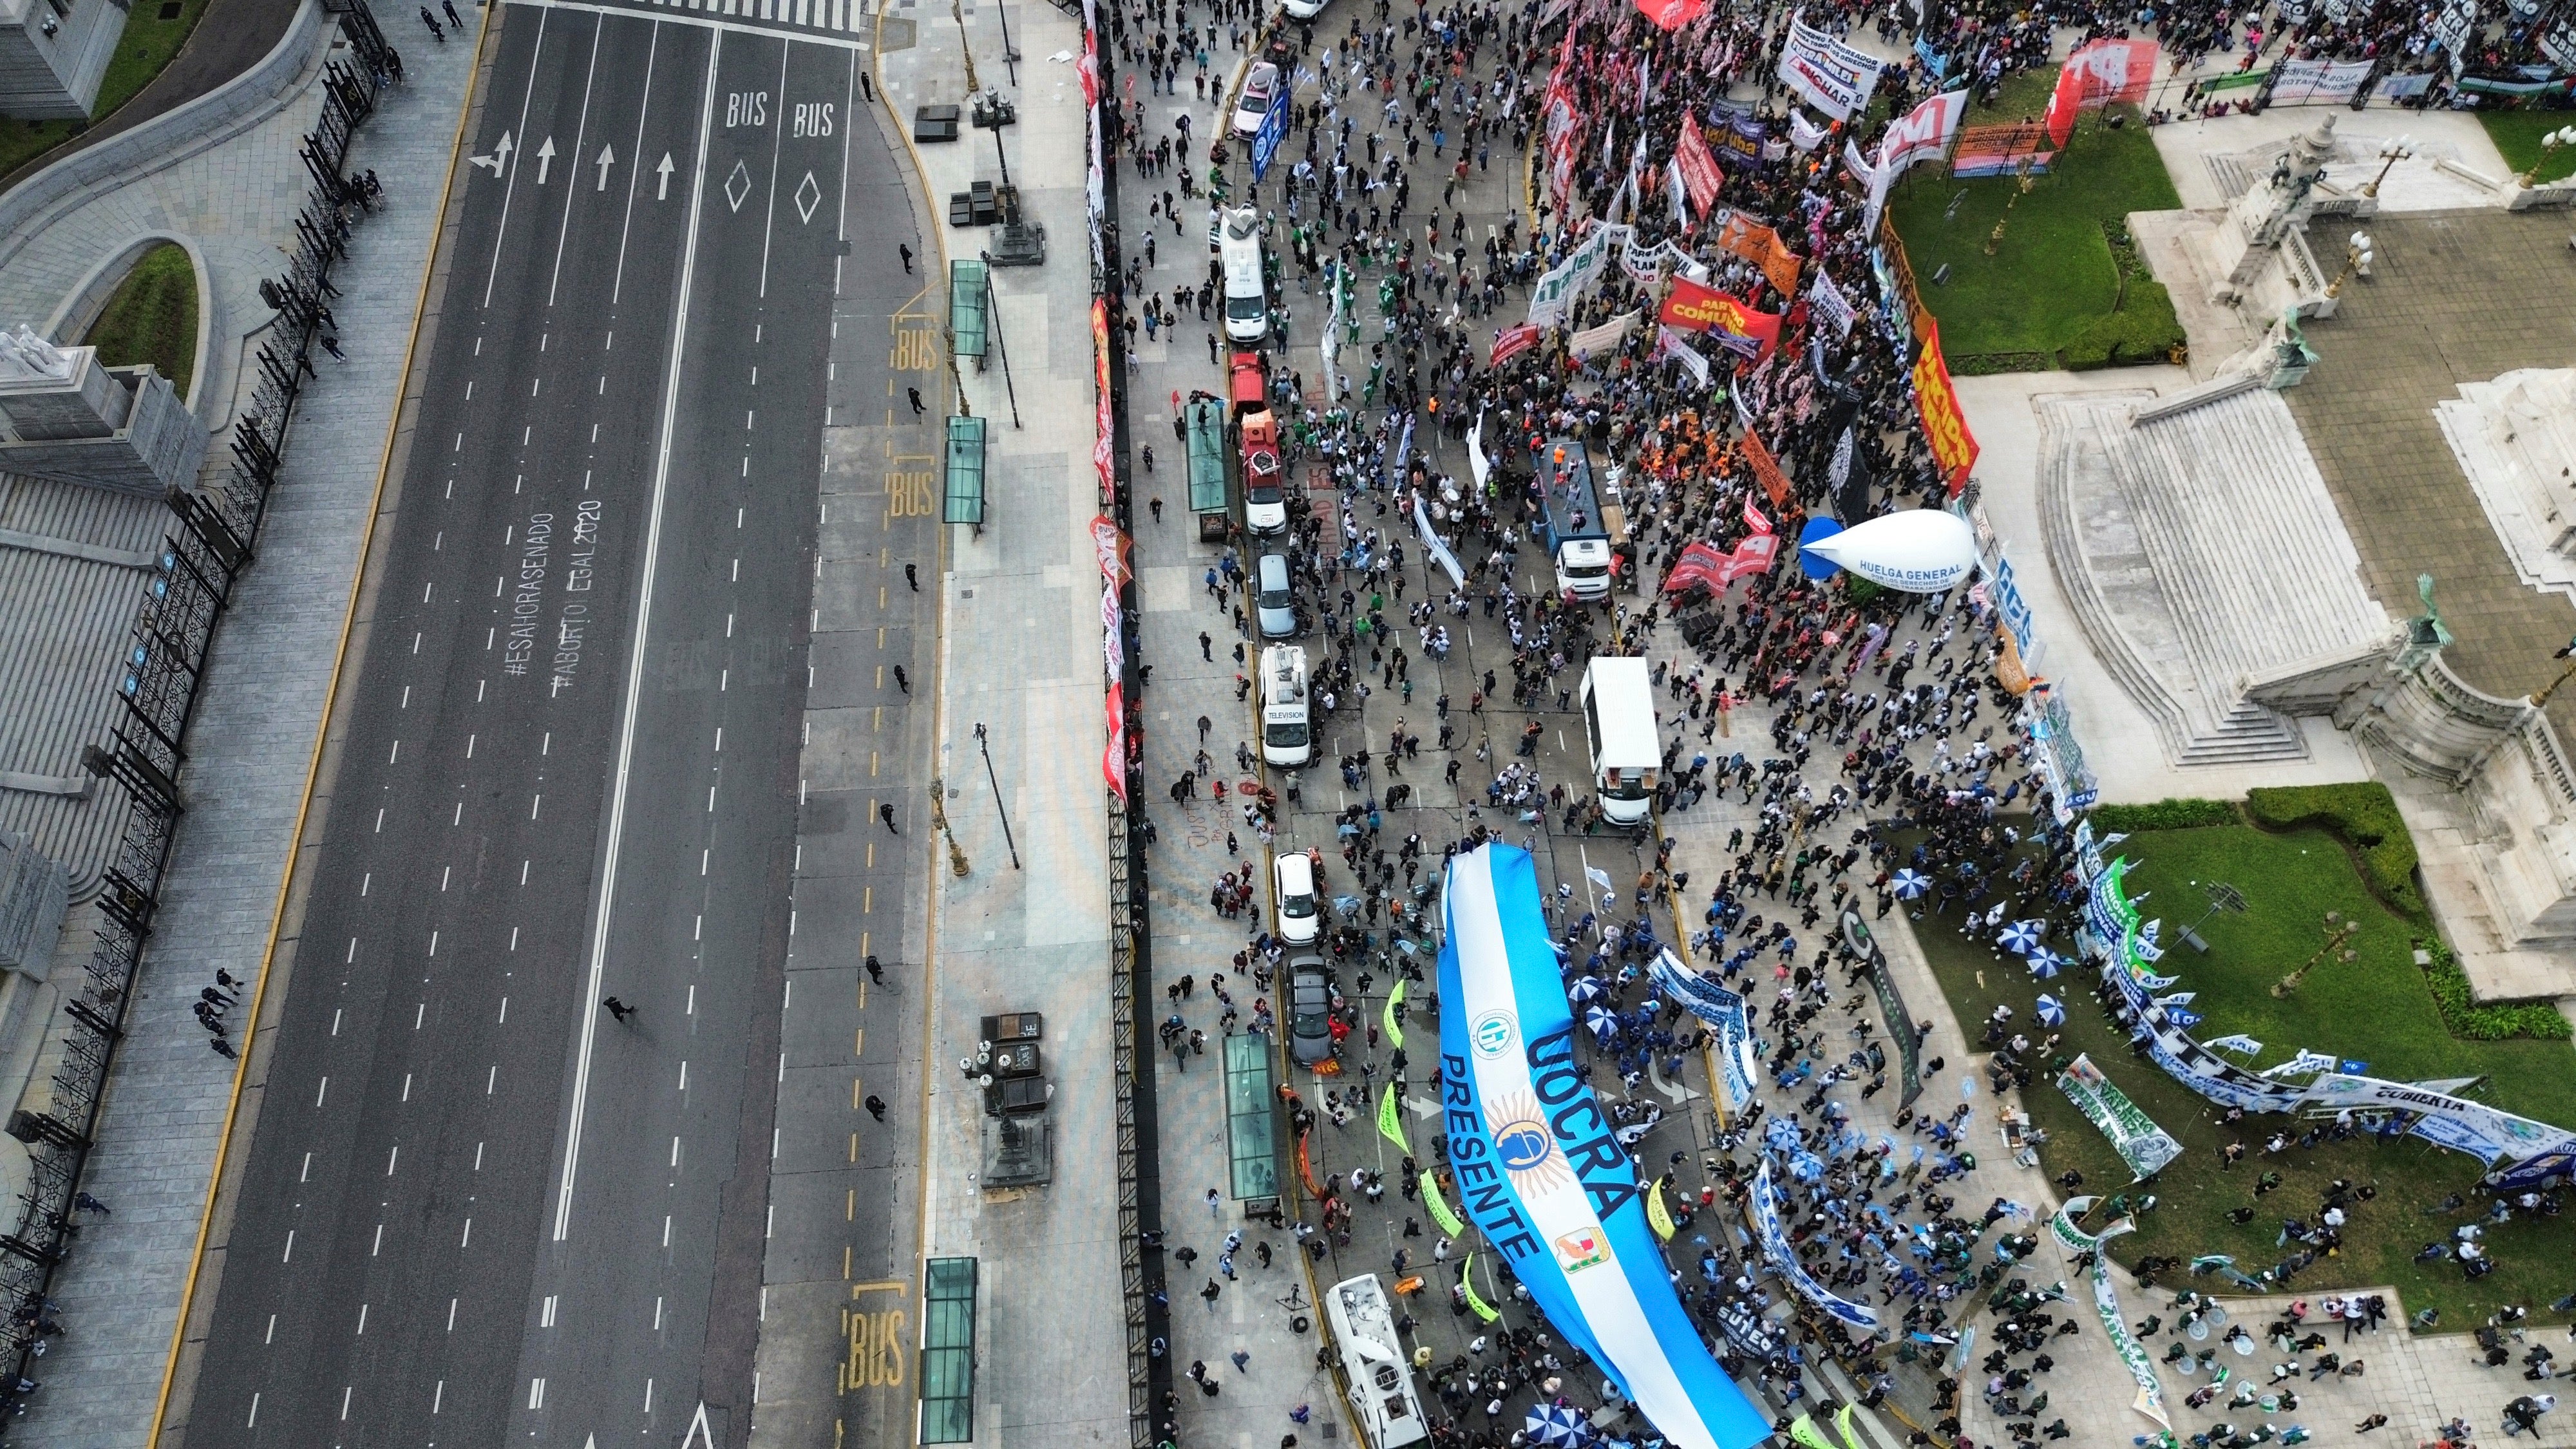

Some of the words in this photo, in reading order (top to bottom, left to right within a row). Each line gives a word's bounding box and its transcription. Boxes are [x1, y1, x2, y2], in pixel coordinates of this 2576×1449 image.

[1823, 57, 1855, 84] MILEI
[726, 91, 767, 128] BUS
[793, 103, 833, 138] BUS
[898, 329, 937, 370] BUS
[891, 472, 934, 517] BUS
[1860, 560, 1903, 579] HUELGA
[1906, 564, 1962, 580] GENERAL
[505, 513, 553, 676] #ESAHORASENADO
[1268, 712, 1304, 720] TELEVISION
[2106, 878, 2128, 918] UNIÓN
[1526, 1030, 1637, 1222] UOCRA
[1442, 1052, 1540, 1264] PRESENTE
[849, 1310, 905, 1389] BUS
